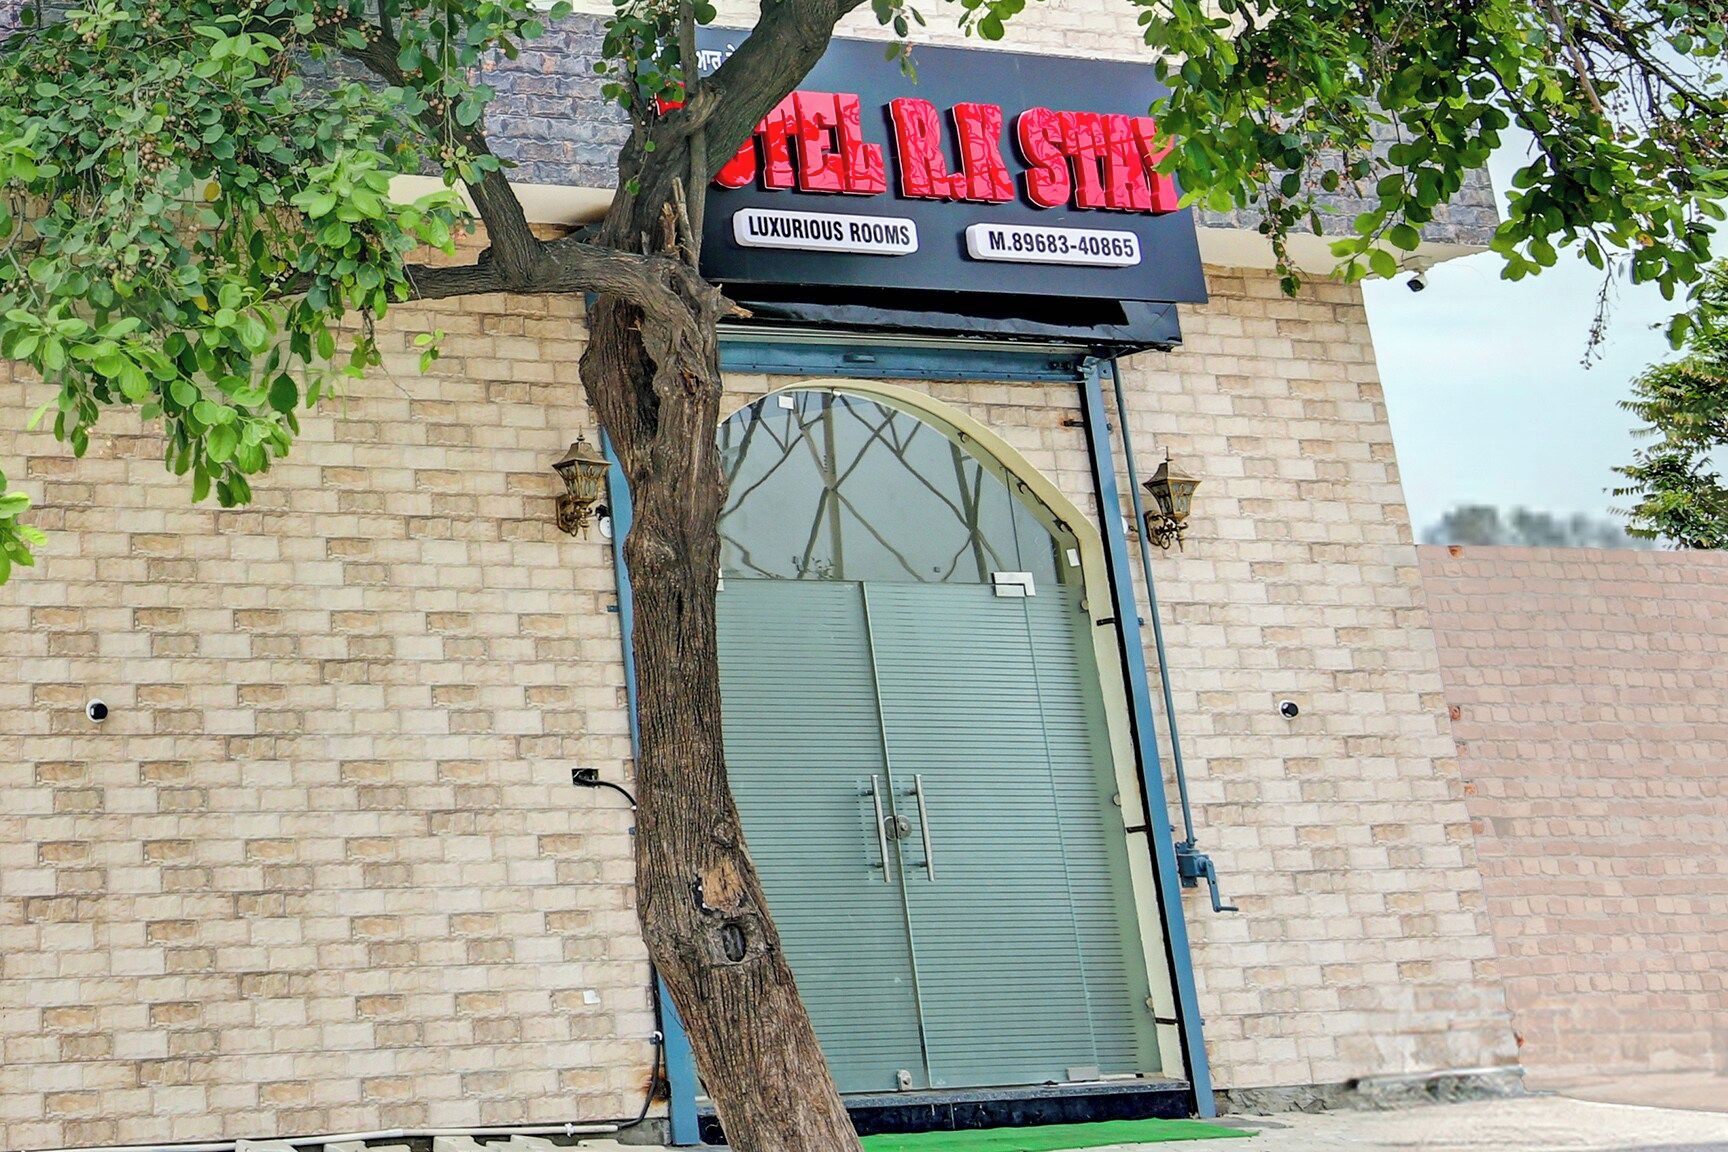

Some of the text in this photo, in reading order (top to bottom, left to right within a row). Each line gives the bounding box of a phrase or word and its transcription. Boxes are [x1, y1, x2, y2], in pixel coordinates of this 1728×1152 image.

[655, 81, 887, 196] TEL
[748, 215, 910, 246] LUXURIOUS ROOMS
[988, 231, 1134, 258] M.89683-40865
